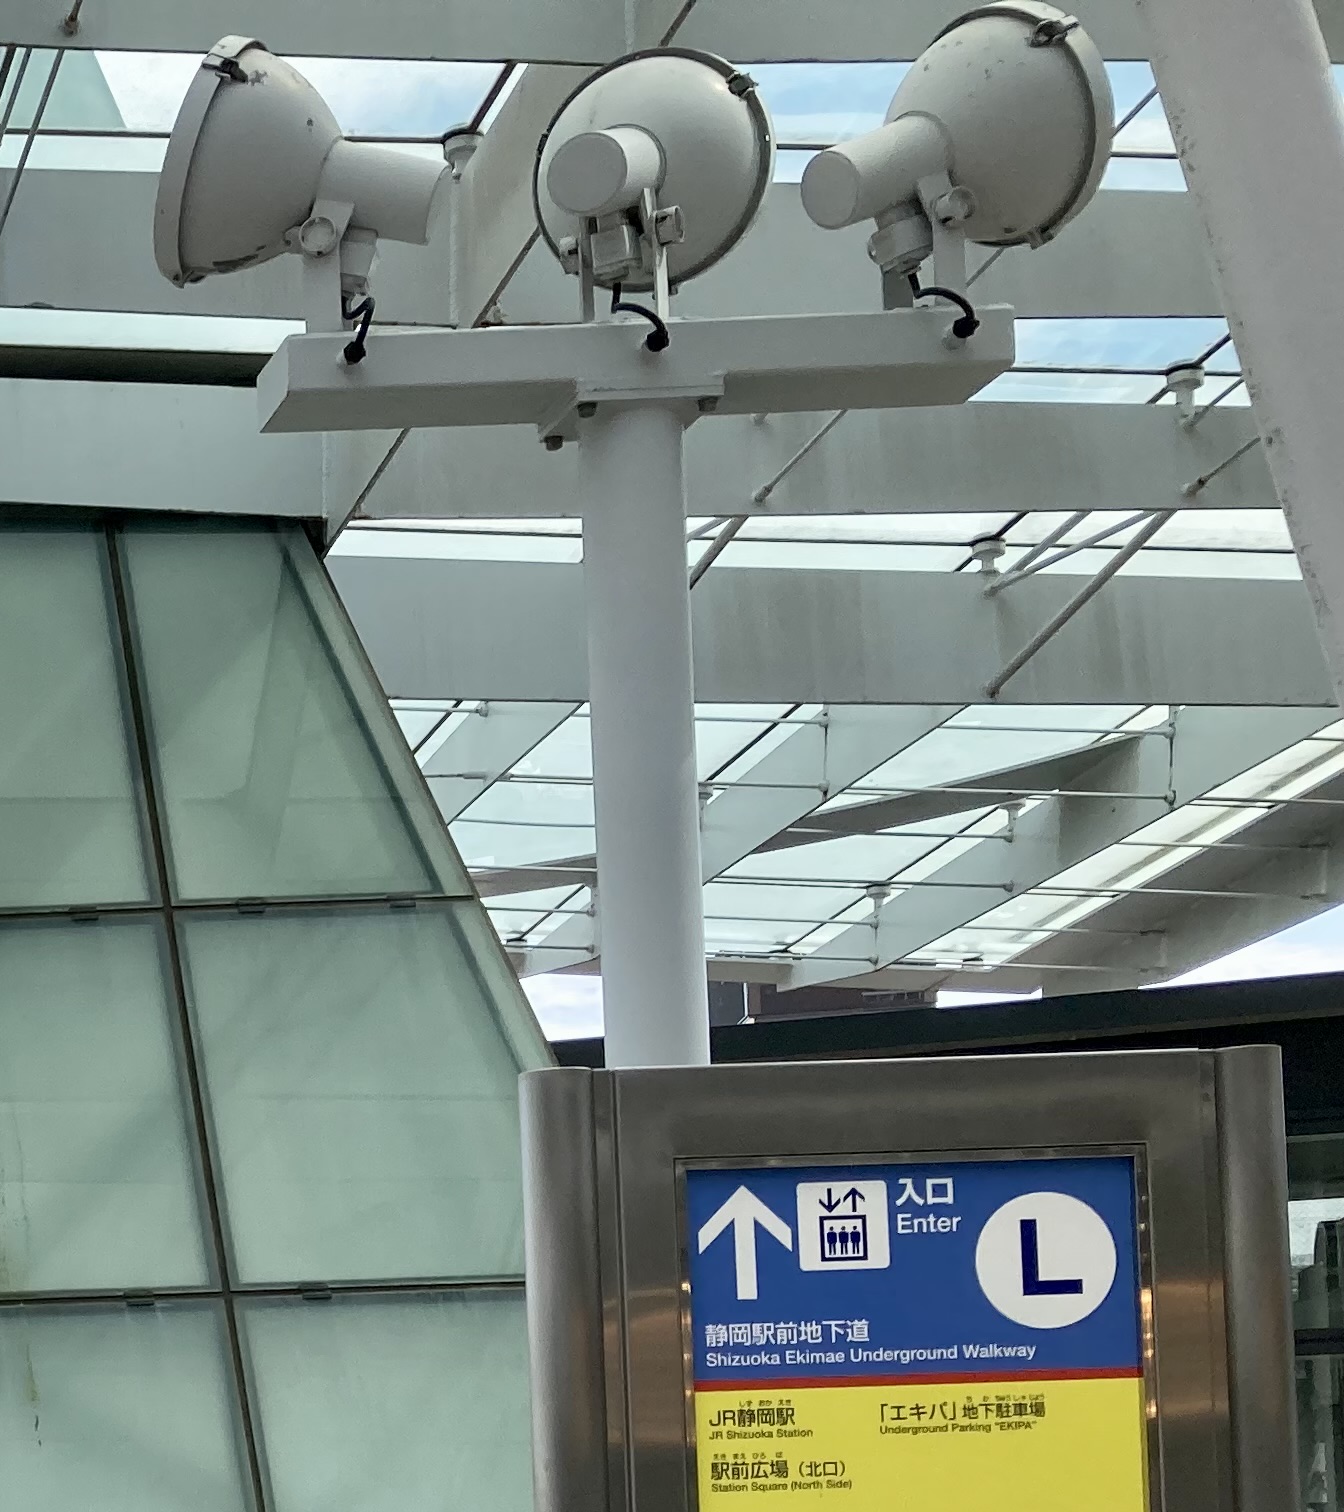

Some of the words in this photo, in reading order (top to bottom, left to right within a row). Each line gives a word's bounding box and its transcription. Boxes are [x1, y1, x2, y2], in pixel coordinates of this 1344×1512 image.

[895, 1178, 954, 1206] 入口
[897, 1212, 961, 1235] Enter
[1019, 1218, 1083, 1296] L
[705, 1319, 870, 1347] 静岡駅前地下道
[706, 1352, 780, 1367] Shizuoka
[785, 1350, 845, 1364] Ekimae
[850, 1346, 958, 1365] Underground
[962, 1344, 1037, 1360] Walkway
[709, 1408, 795, 1427] JR静岡駅
[880, 1423, 948, 1435] Underground
[951, 1422, 991, 1433] Parking
[709, 1431, 723, 1440] JR
[727, 1430, 773, 1440] Shizuoka
[776, 1428, 813, 1438] Station
[712, 1483, 748, 1492] Station
[752, 1482, 787, 1492] Square
[791, 1480, 822, 1491] (North
[826, 1479, 852, 1490] Side)
